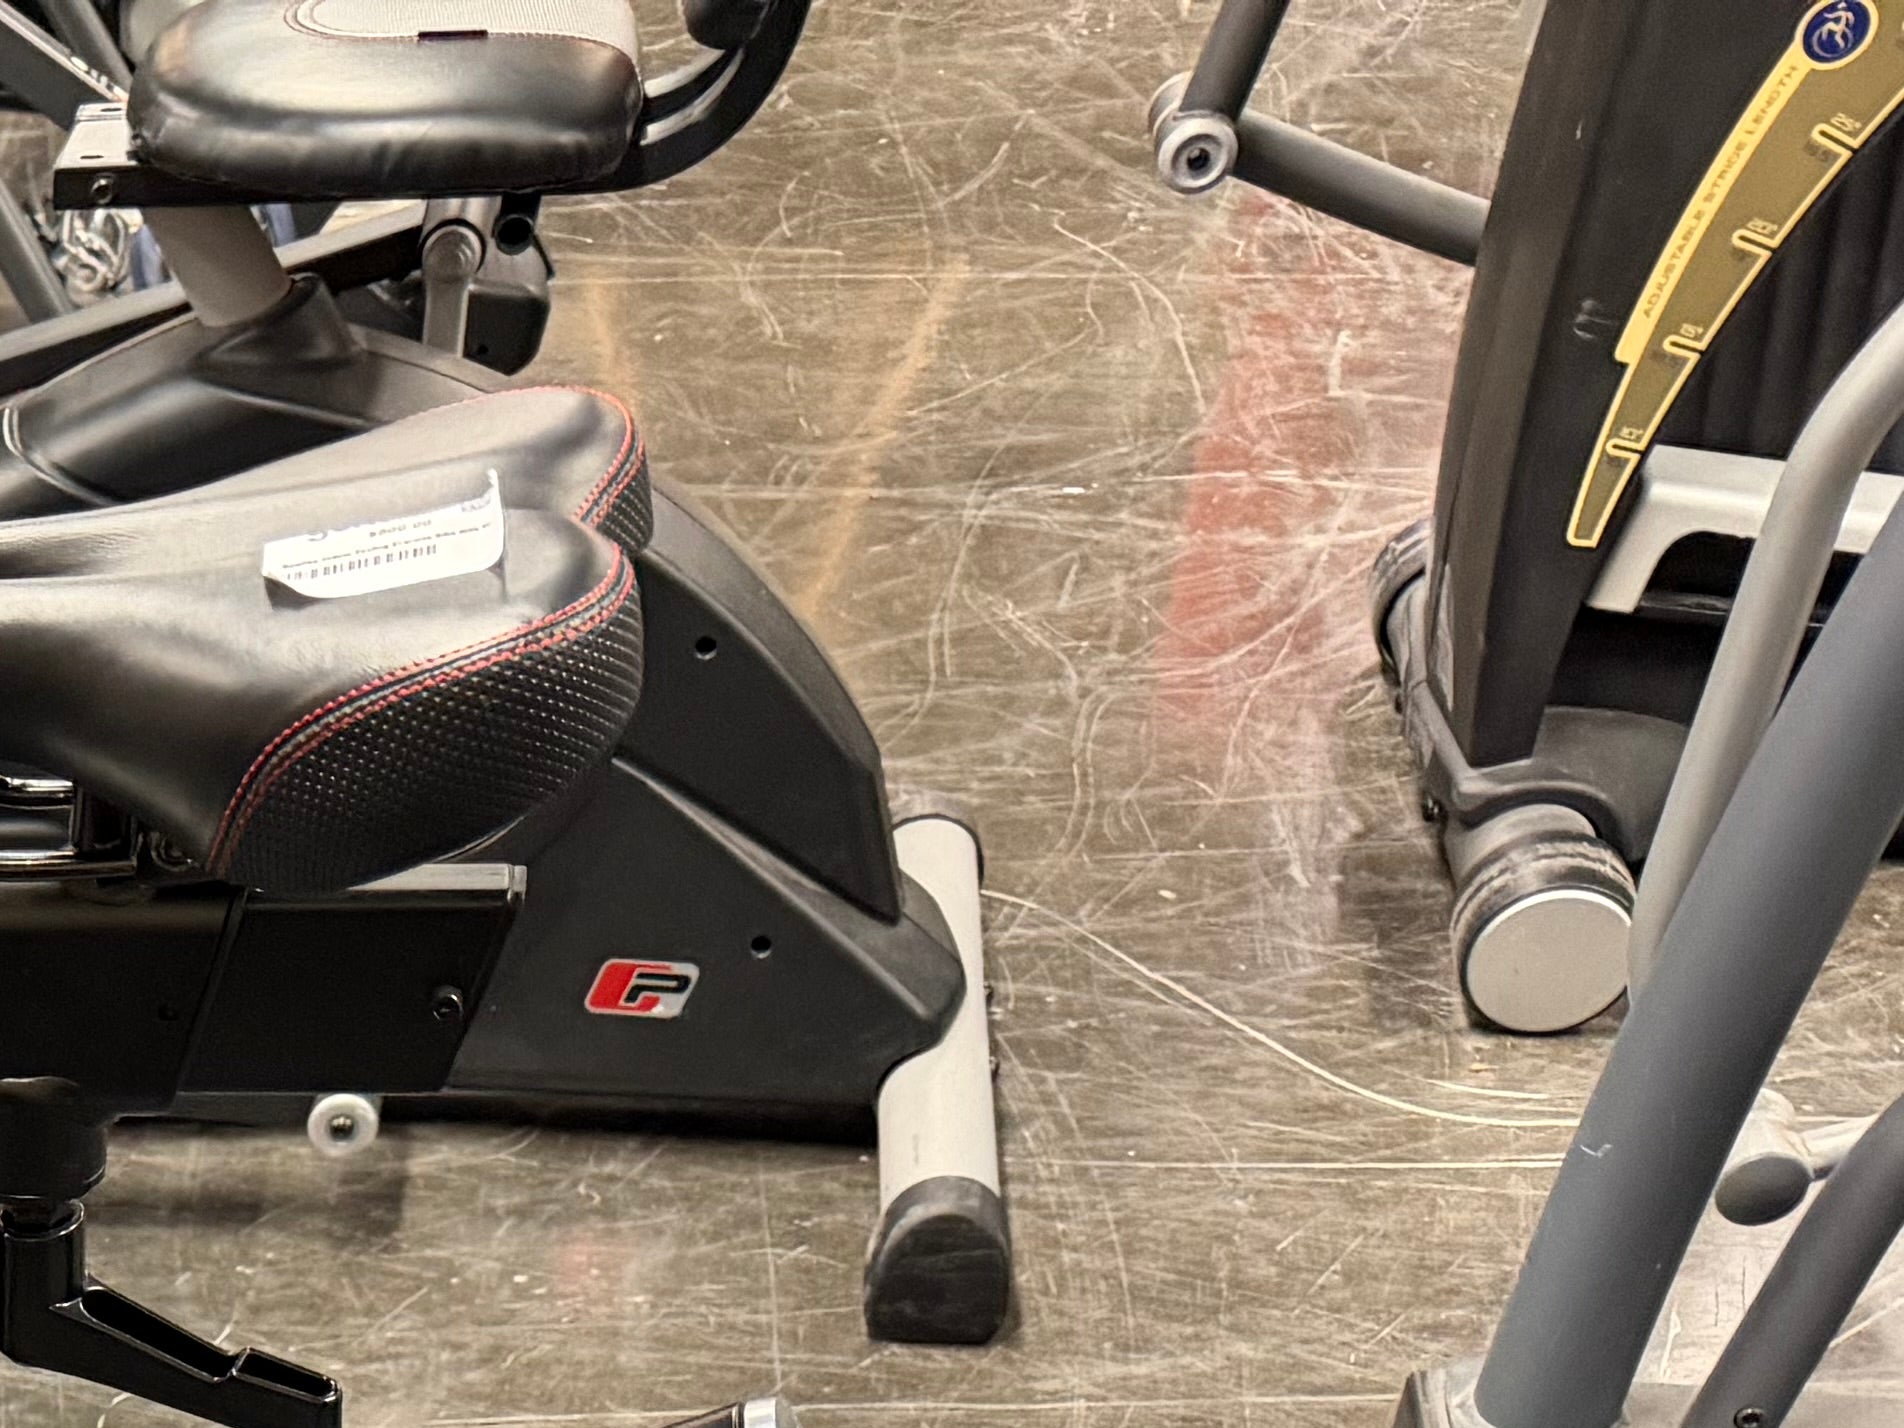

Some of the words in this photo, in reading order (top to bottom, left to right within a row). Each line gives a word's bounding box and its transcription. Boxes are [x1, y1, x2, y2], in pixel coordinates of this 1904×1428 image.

[1642, 209, 1707, 320] ADJUSTABLE
[1703, 142, 1745, 204] STRIDE
[1744, 64, 1799, 136] LENGTH
